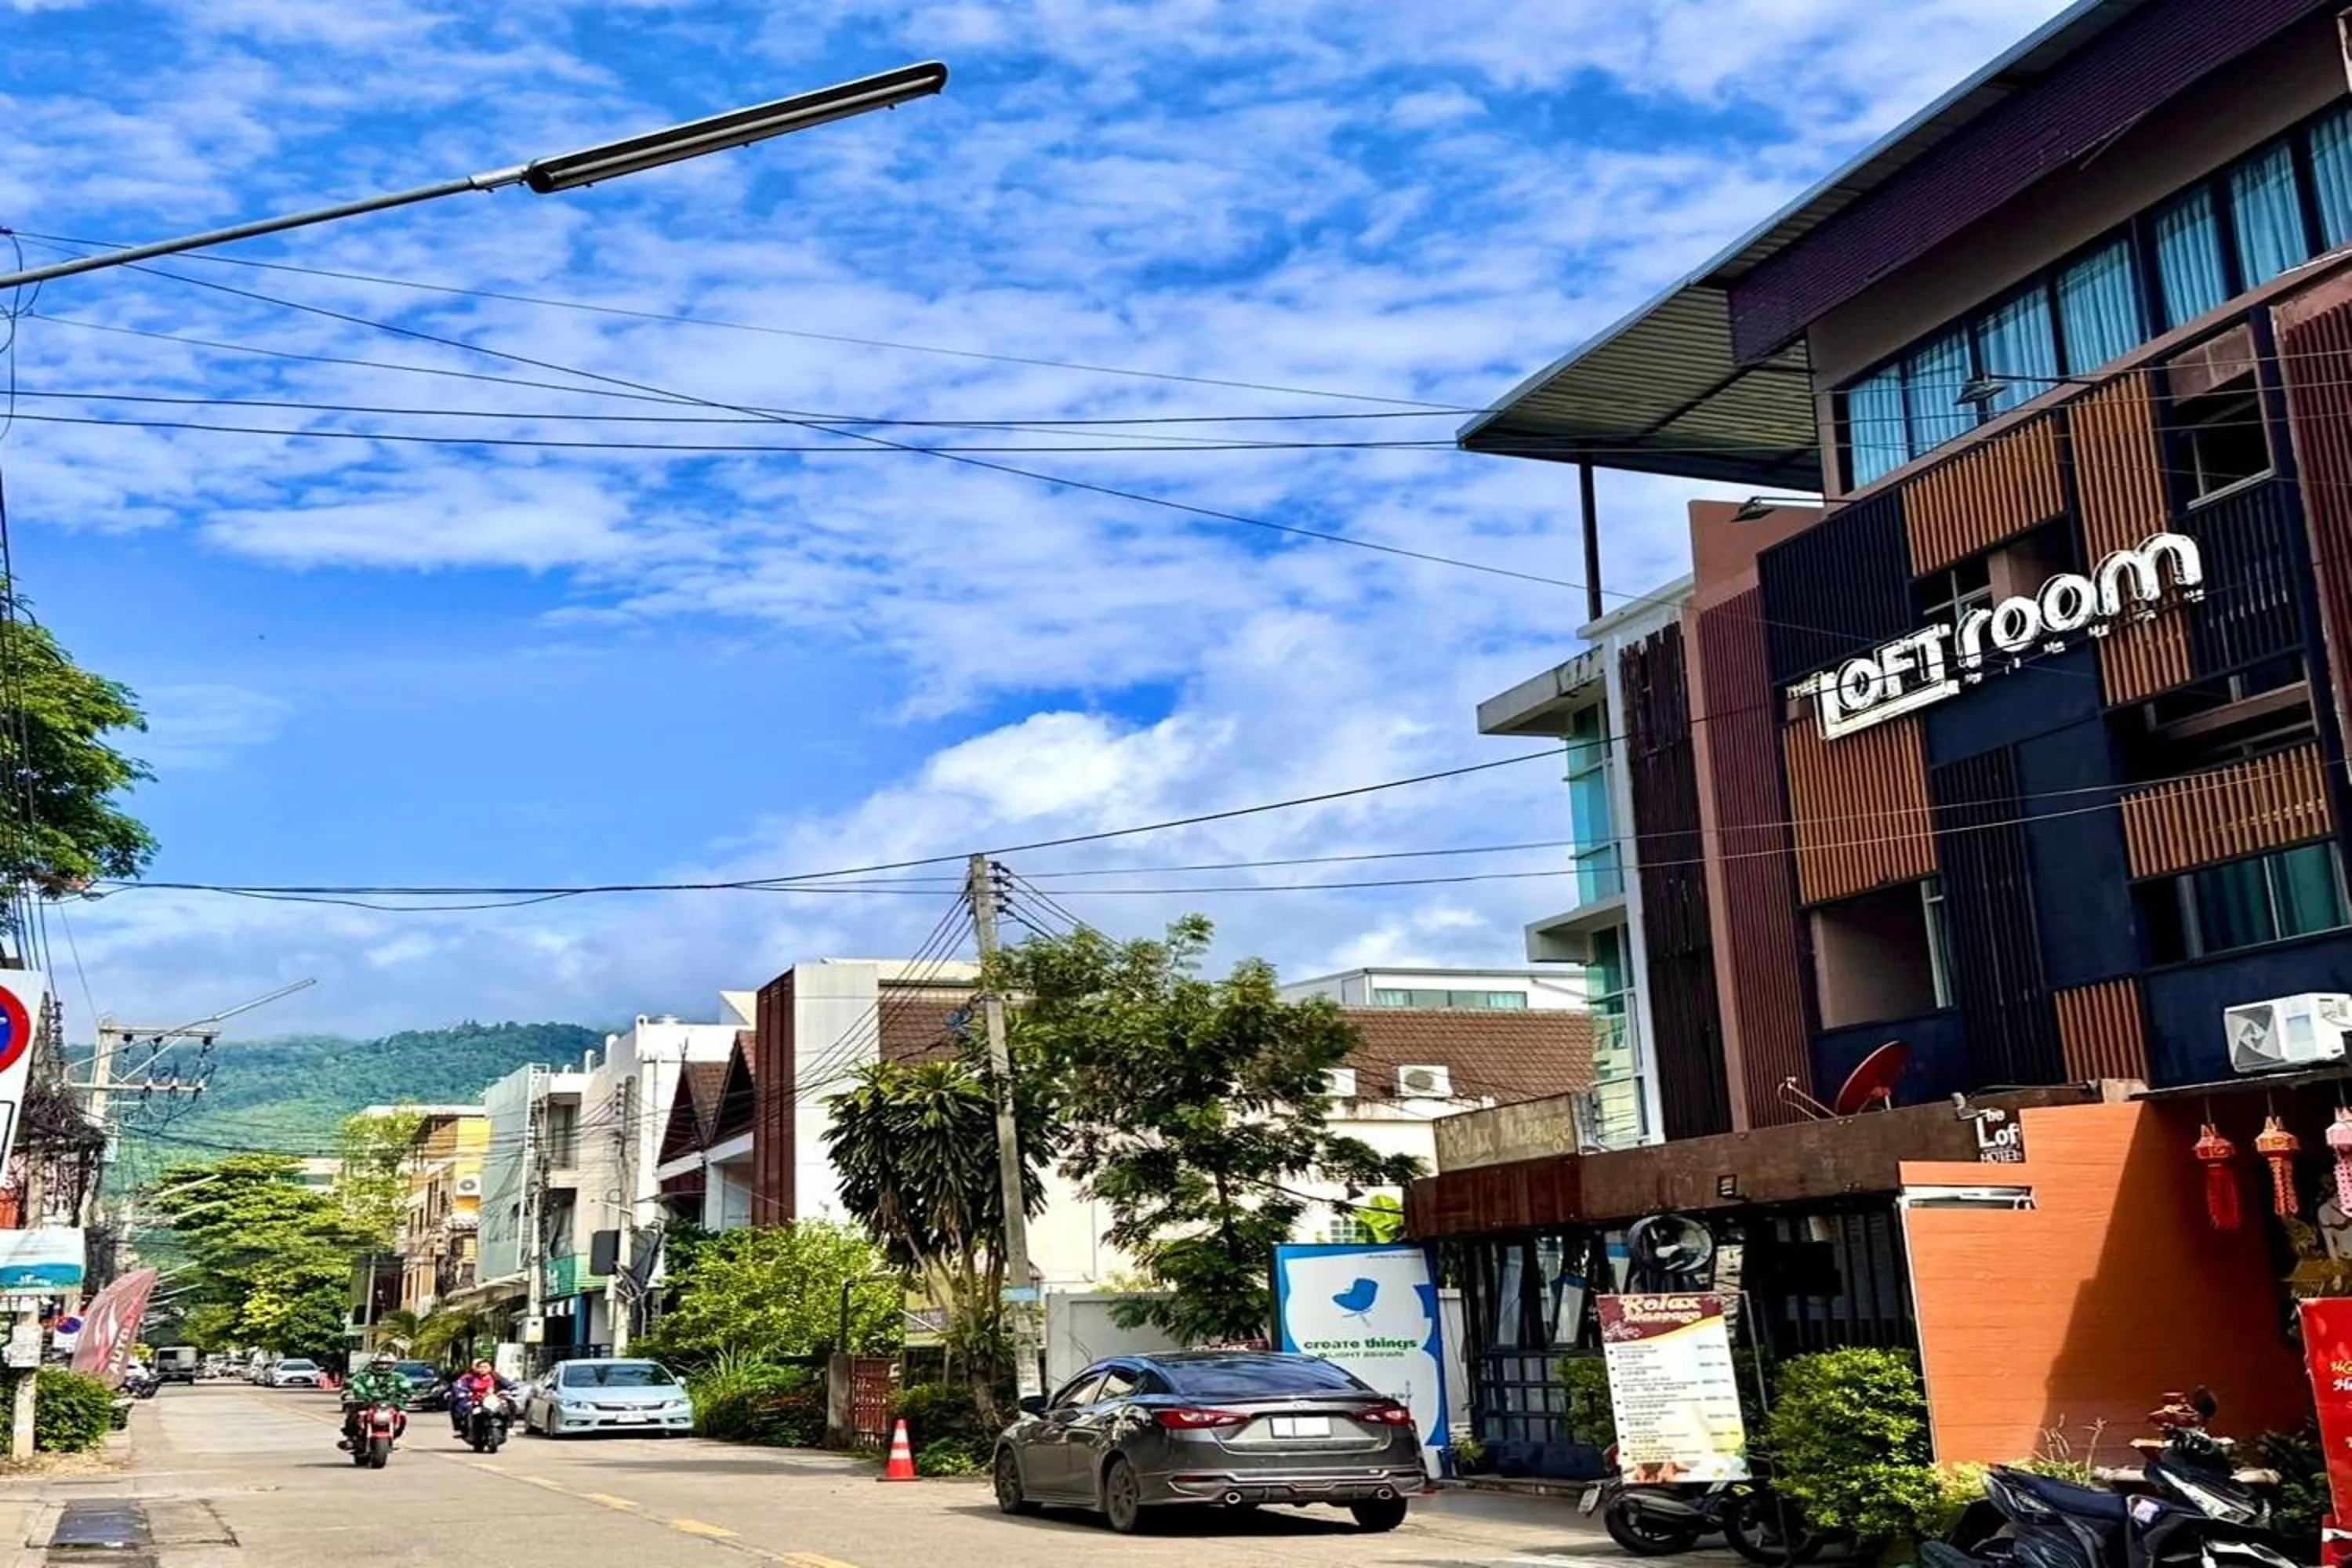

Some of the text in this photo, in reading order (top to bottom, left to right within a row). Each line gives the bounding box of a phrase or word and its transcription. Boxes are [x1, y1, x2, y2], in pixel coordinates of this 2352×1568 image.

[1955, 532, 2205, 669] room
[1304, 1337, 1417, 1350] create things
